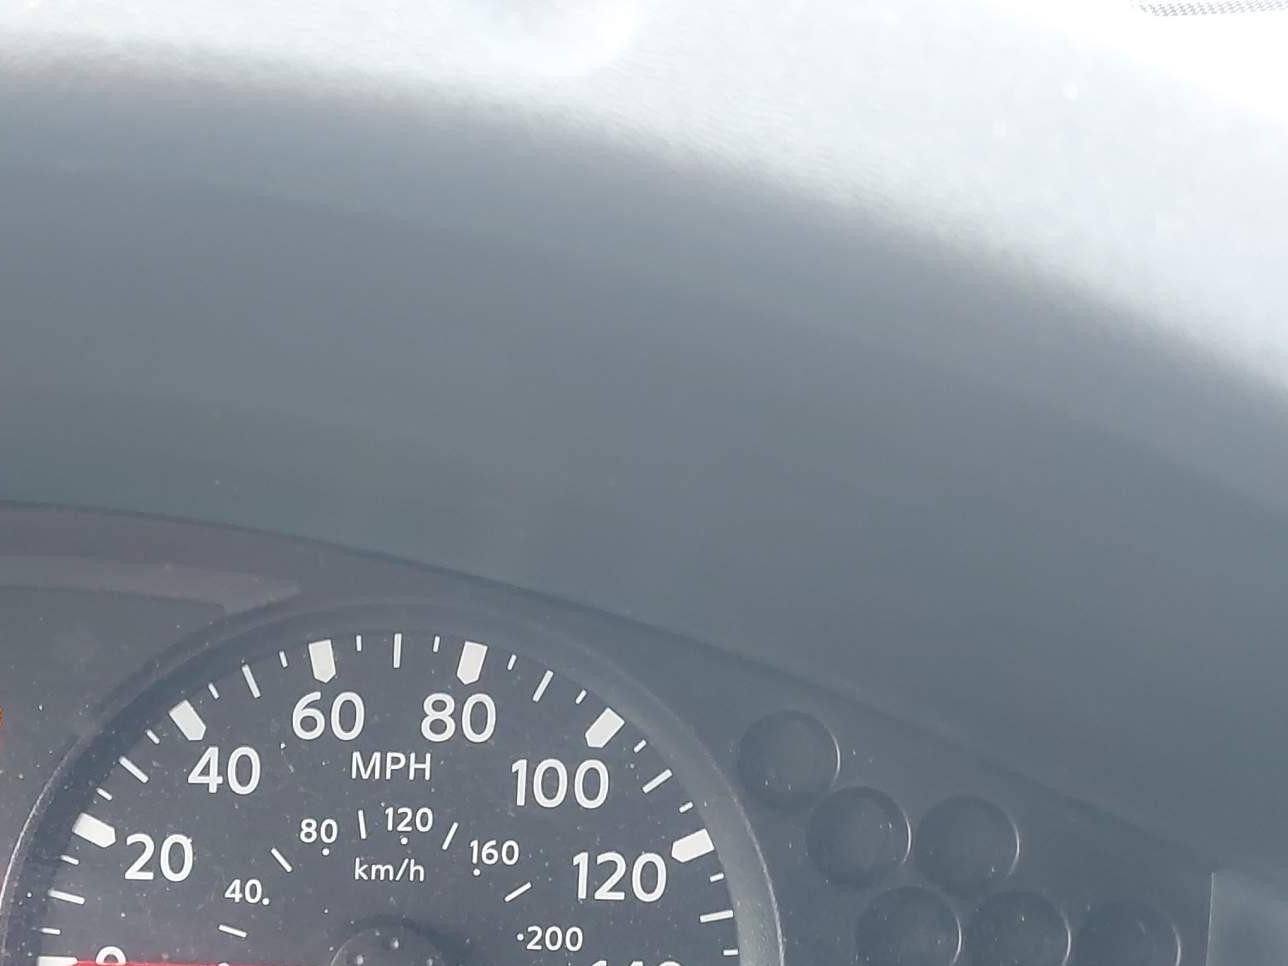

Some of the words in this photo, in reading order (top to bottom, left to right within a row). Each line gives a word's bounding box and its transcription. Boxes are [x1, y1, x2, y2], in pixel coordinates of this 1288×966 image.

[291, 691, 365, 741] 60
[420, 693, 497, 744] 80
[188, 747, 262, 795] 40
[351, 752, 432, 781] MPH
[512, 759, 610, 809] 100
[300, 818, 339, 845] 80
[384, 807, 433, 833] 120
[125, 834, 193, 883] 20
[354, 857, 426, 884] km/h
[470, 839, 520, 867] 160
[573, 851, 667, 903] 120
[526, 926, 584, 952] 200
